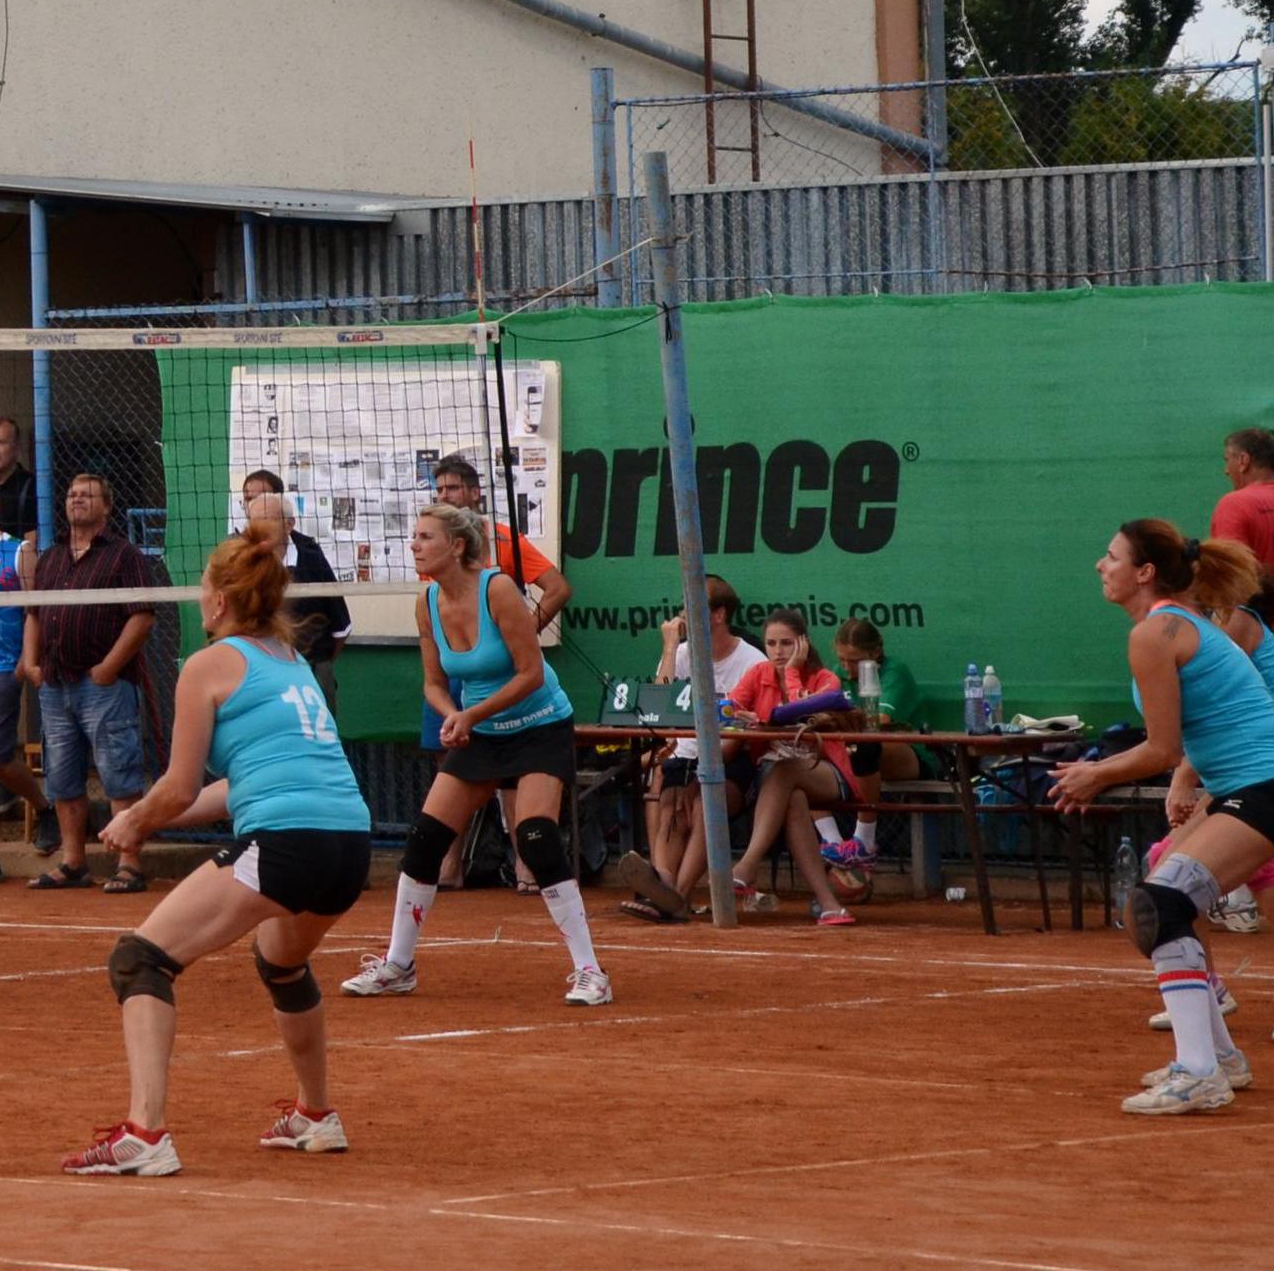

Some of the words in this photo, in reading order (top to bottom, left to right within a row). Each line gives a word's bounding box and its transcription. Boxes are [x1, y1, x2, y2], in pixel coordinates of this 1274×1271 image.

[280, 684, 337, 744] 12
[613, 683, 629, 710] 8
[675, 684, 691, 711] 4
